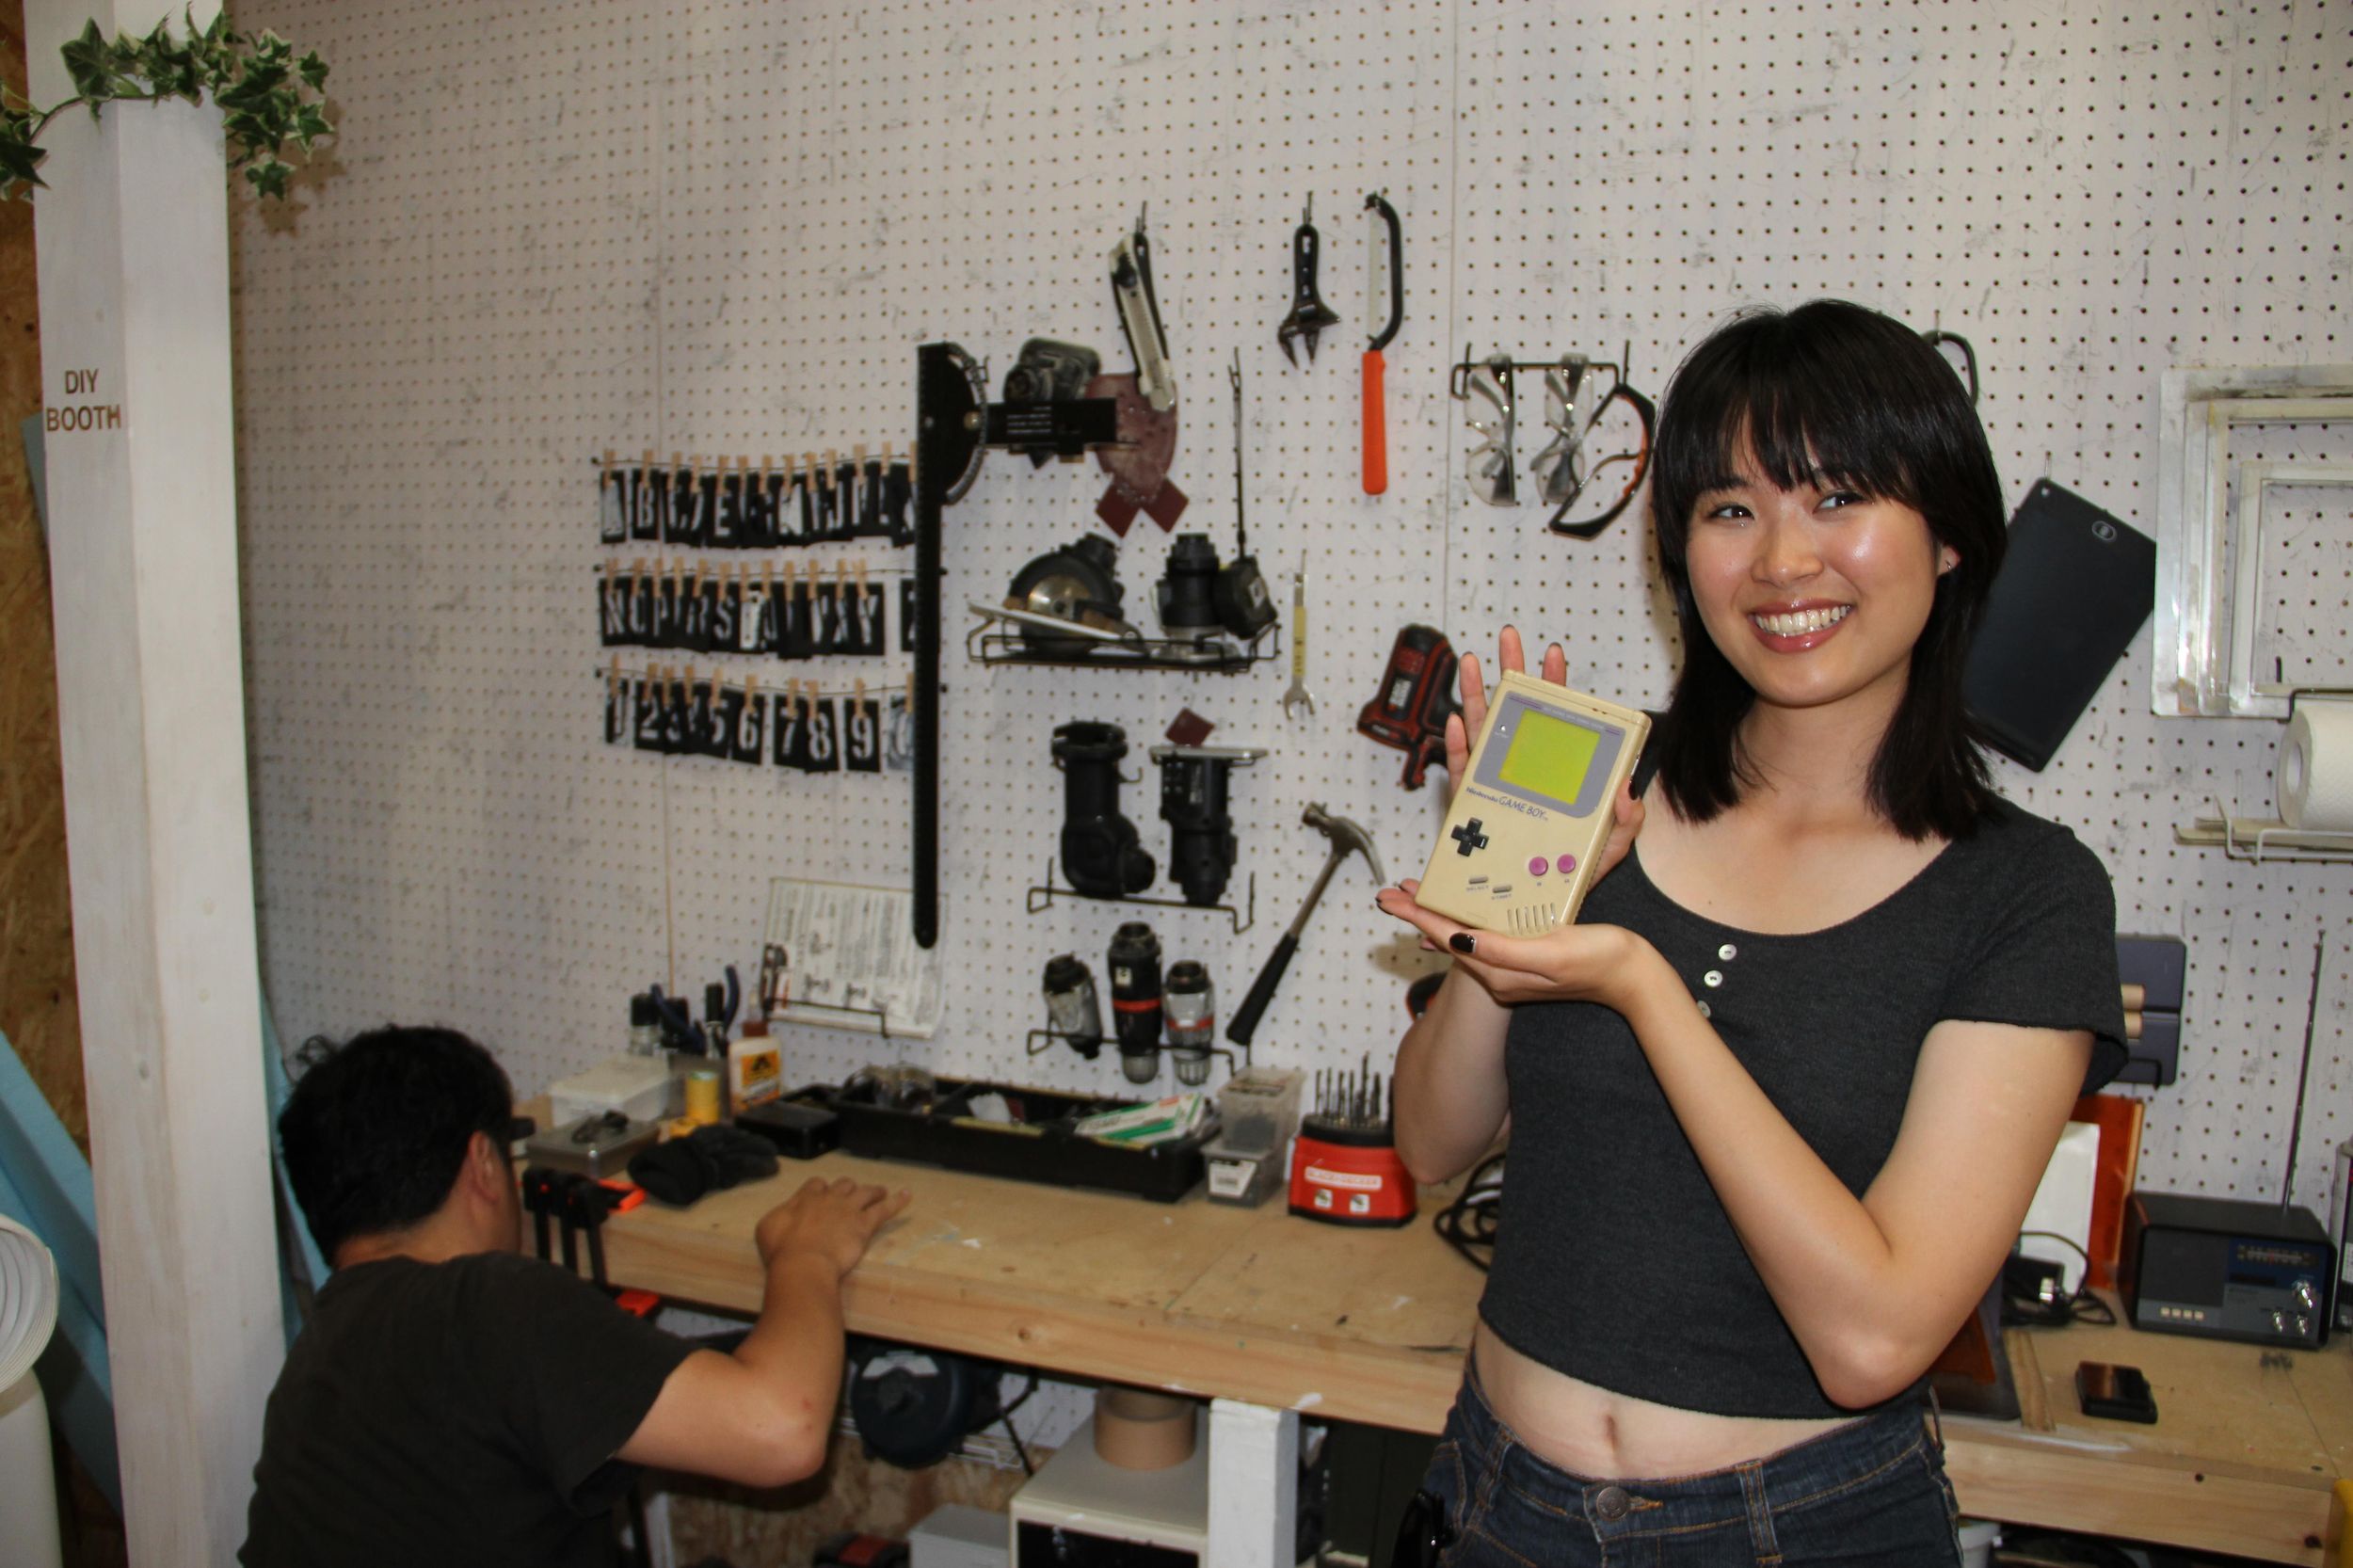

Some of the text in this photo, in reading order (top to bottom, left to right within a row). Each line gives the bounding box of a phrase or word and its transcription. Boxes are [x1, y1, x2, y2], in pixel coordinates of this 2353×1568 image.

[64, 368, 99, 394] DIY
[45, 405, 121, 432] BOOTH
[1498, 796, 1528, 812] GAME
[1527, 806, 1546, 818] BOY
